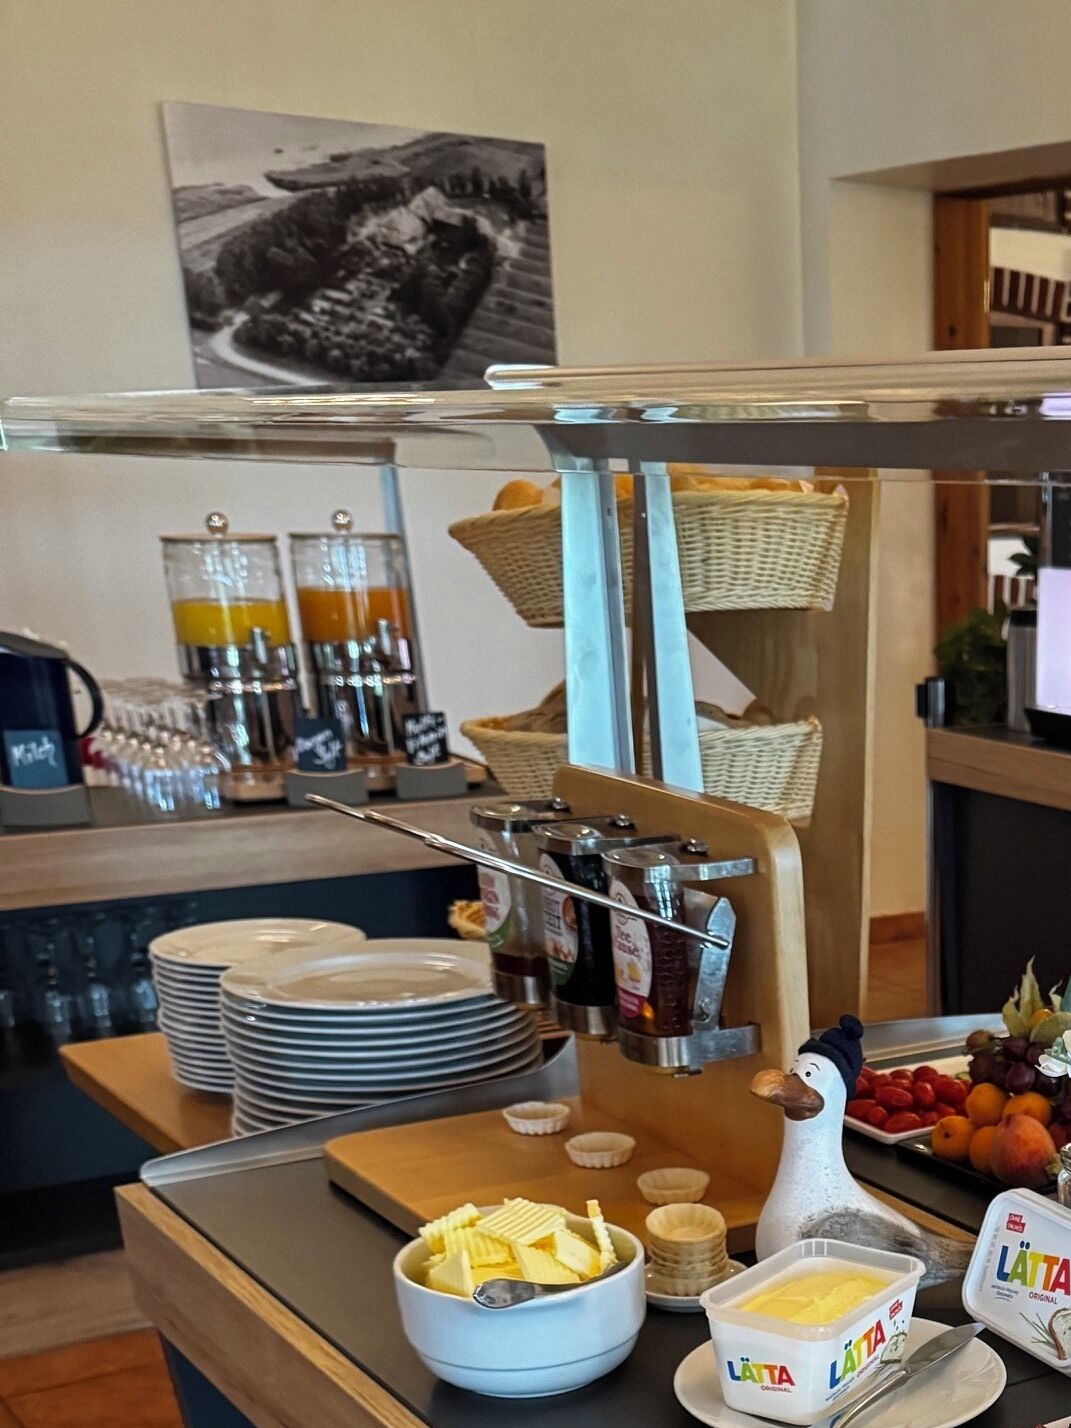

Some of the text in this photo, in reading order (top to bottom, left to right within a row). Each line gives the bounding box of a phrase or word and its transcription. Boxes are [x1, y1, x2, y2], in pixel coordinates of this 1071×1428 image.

[11, 735, 58, 768] Milch
[996, 1240, 1071, 1296] LÄTTA
[1028, 1291, 1058, 1305] ORIGINAL
[829, 1319, 887, 1390] LÄTTA
[726, 1356, 796, 1387] LÄTTA
[760, 1385, 793, 1394] ORIGINAL
